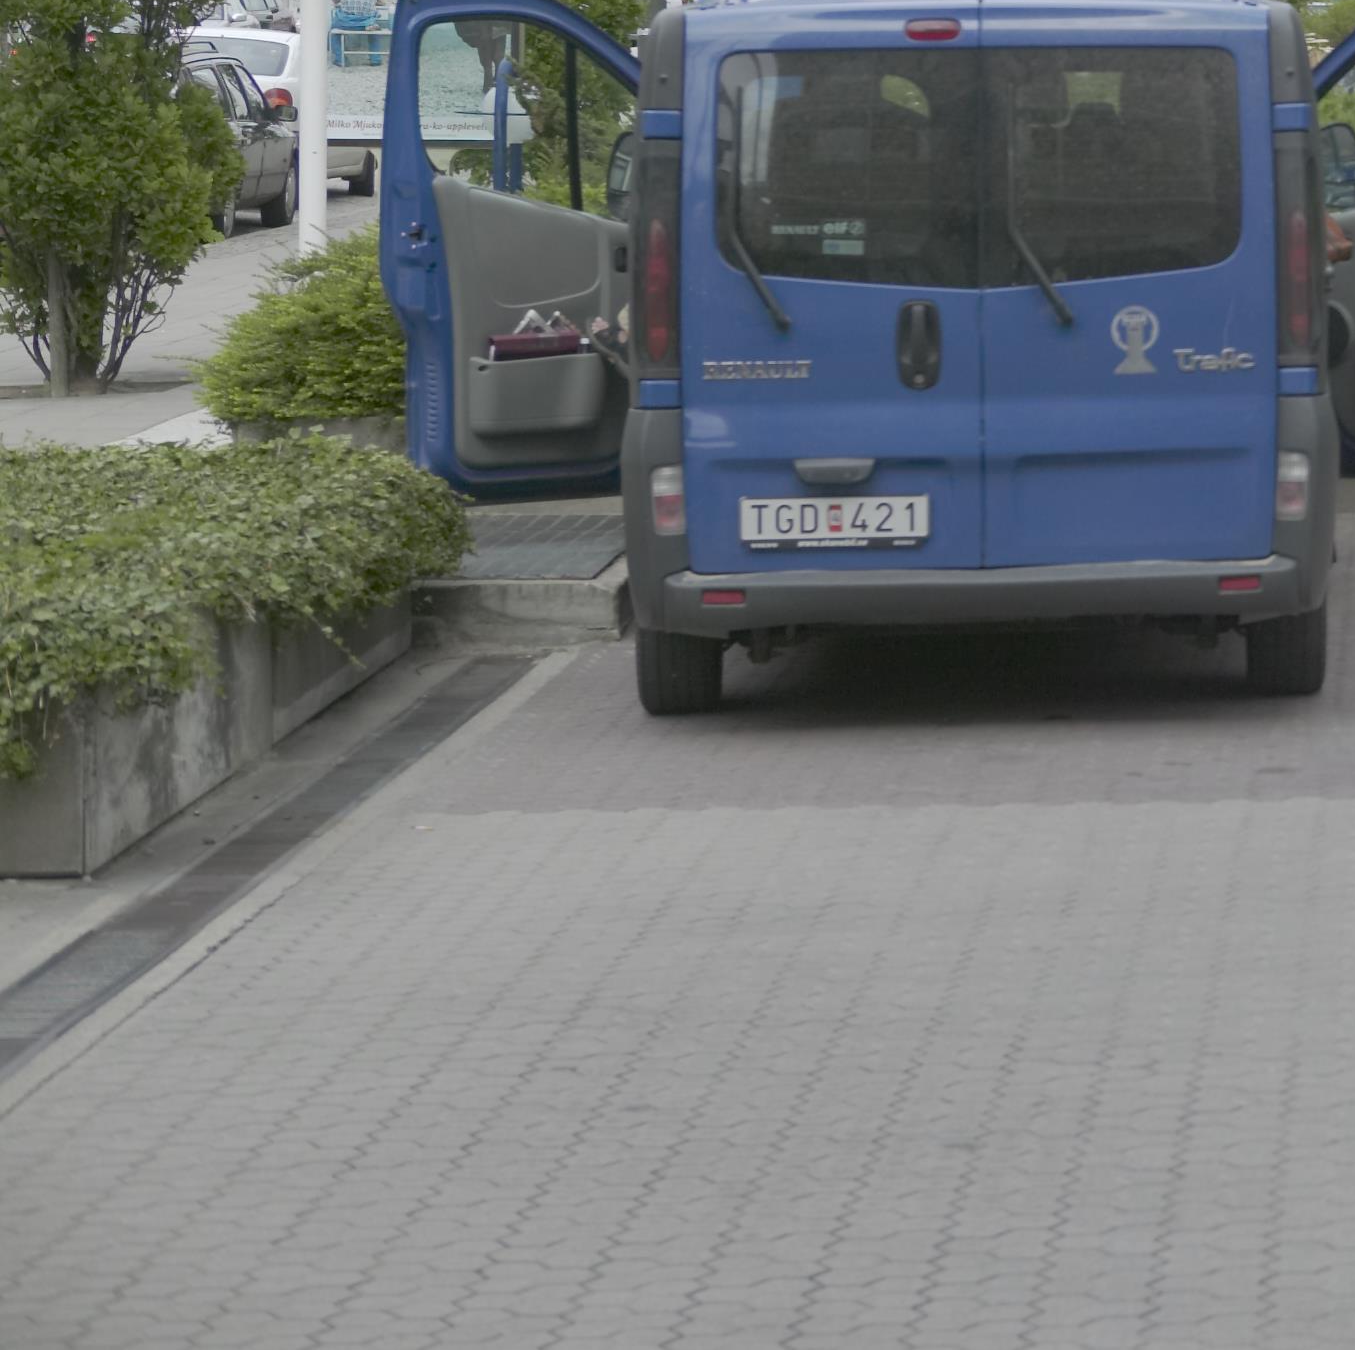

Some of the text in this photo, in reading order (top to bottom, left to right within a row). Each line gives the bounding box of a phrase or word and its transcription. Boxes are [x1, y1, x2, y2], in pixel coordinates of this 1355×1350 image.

[703, 361, 812, 380] RENAULT
[1173, 347, 1256, 372] Trafic
[751, 504, 819, 534] TGD
[851, 502, 915, 532] 421
